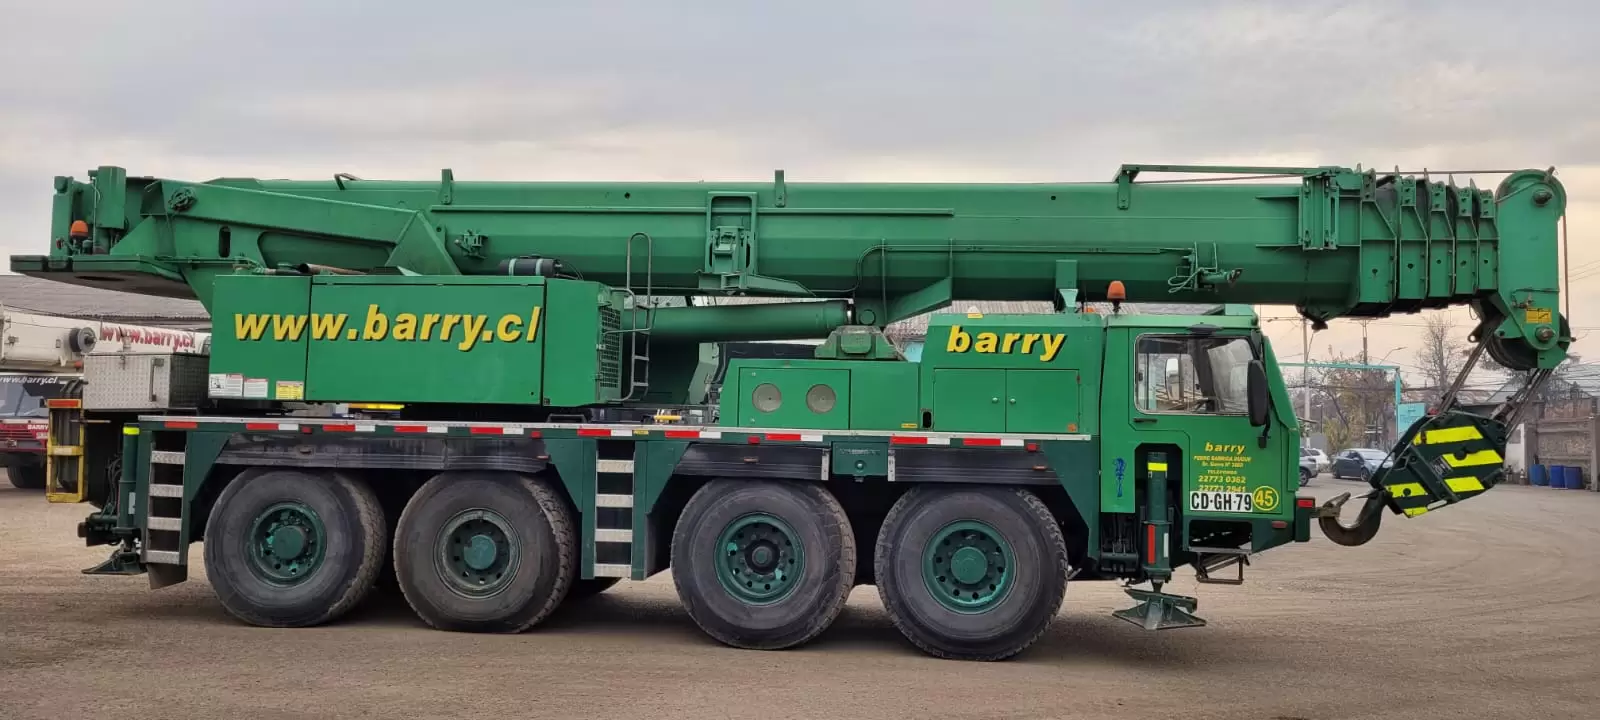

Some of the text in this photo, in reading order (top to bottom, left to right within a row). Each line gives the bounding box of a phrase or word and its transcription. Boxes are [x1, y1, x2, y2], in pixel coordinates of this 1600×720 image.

[234, 304, 543, 351] www.barry.cl
[946, 325, 1067, 361] barry
[0, 376, 58, 385] ww.barry.cl
[1205, 442, 1245, 455] barry
[1225, 476, 1246, 484] 0362
[1255, 490, 1274, 507] 45
